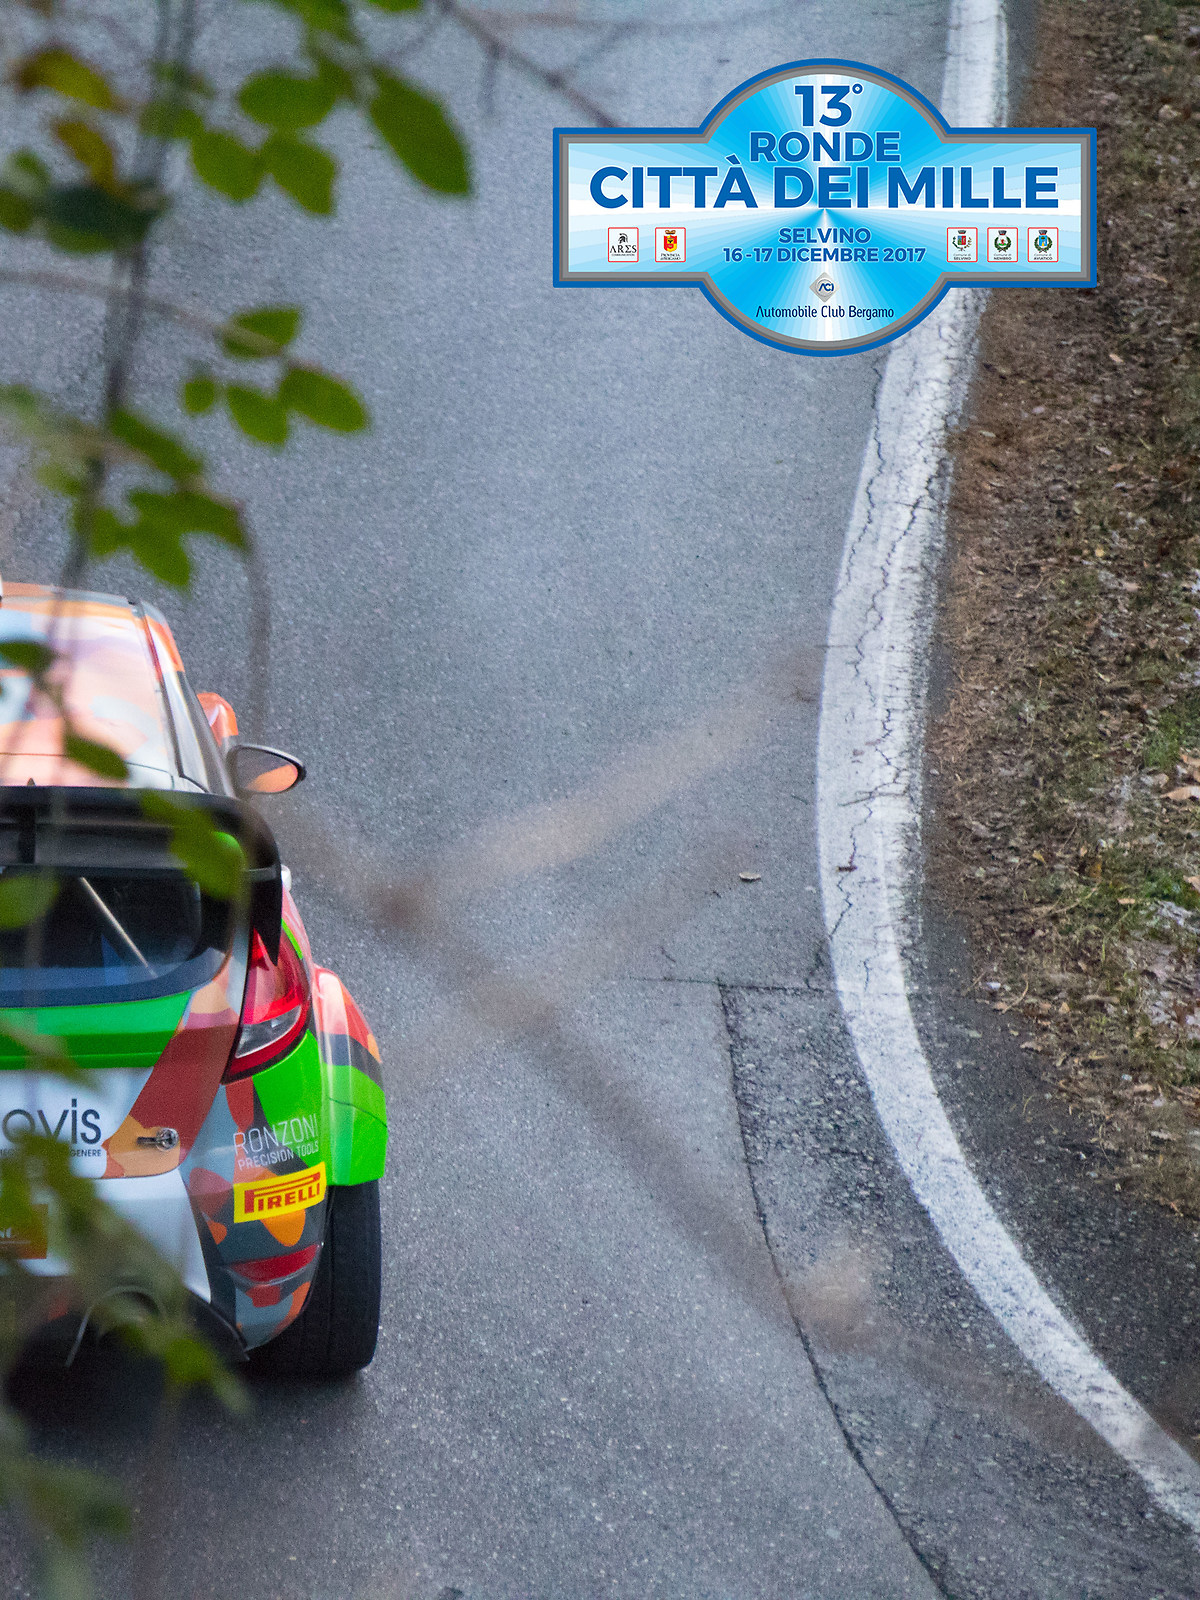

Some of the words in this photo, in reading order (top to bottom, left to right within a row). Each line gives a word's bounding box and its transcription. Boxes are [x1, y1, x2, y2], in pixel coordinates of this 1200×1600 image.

[232, 1113, 319, 1156] RONZONI
[237, 1148, 294, 1171] PRECISION
[296, 1140, 319, 1158] TOOLS
[244, 1171, 321, 1214] PIRELLI
